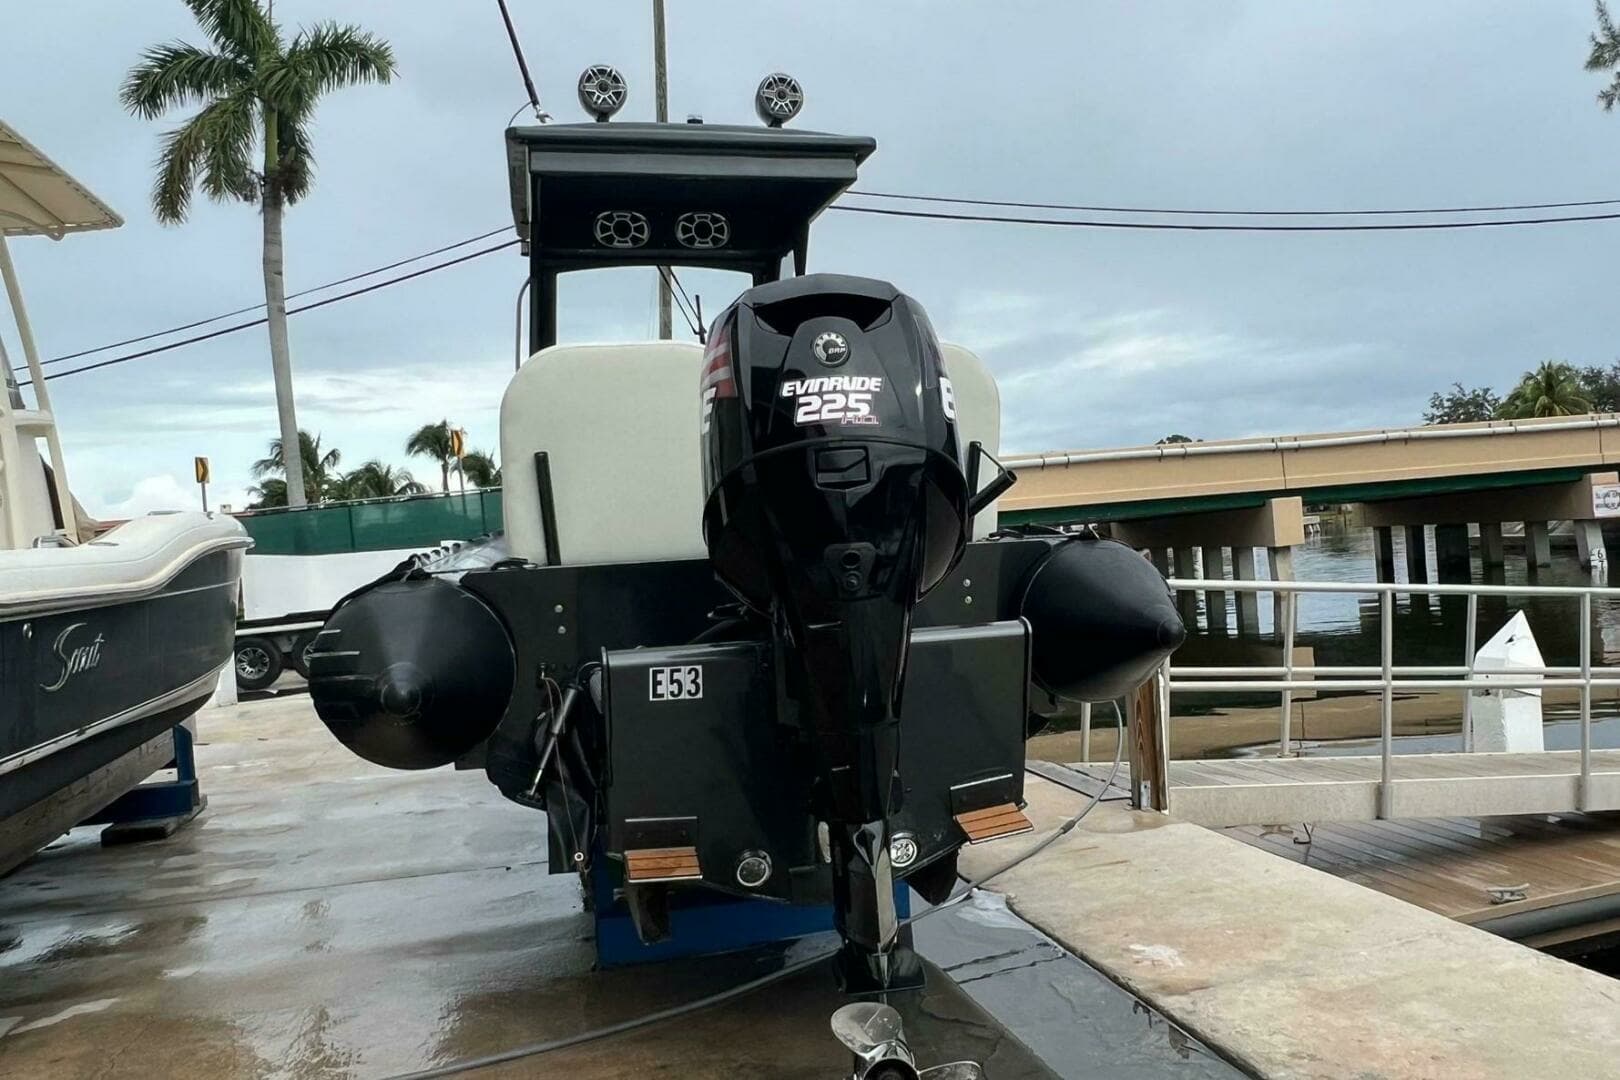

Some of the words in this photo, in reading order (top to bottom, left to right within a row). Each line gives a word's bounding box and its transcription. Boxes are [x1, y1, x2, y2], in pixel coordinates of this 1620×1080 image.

[782, 376, 882, 397] EVINRUDE
[796, 392, 872, 423] 225
[651, 667, 701, 699] E53
